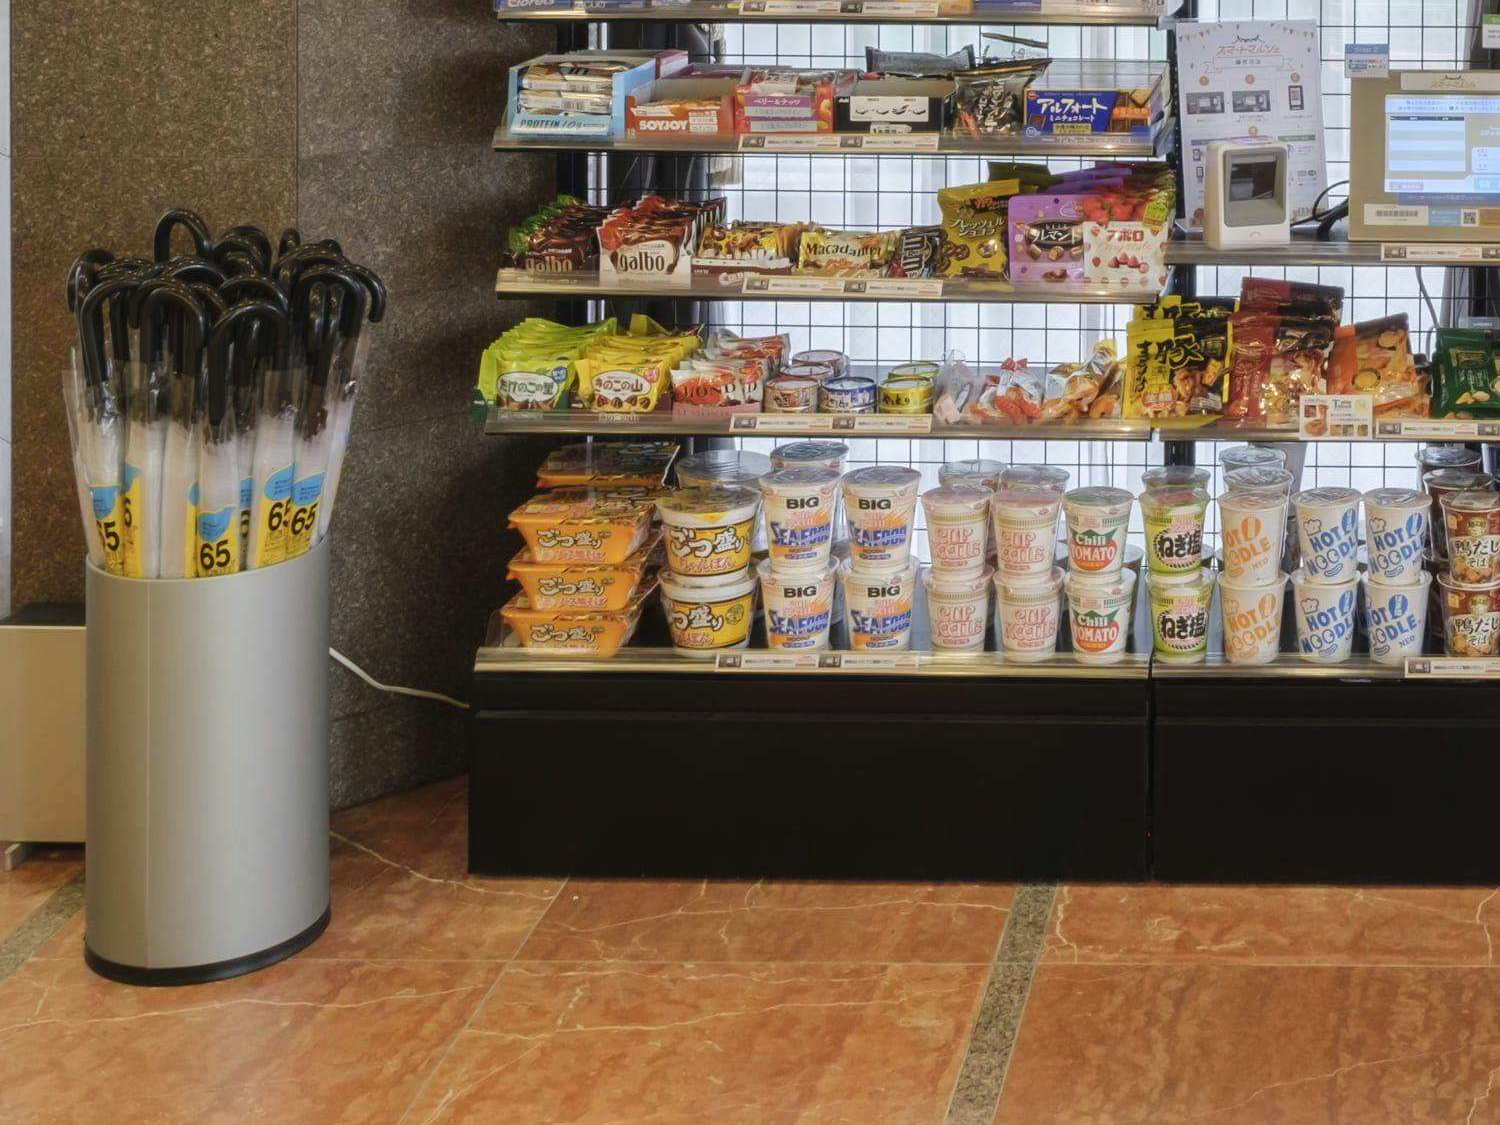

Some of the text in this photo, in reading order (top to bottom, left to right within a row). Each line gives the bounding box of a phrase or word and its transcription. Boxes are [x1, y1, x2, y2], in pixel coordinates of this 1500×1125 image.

[1036, 98, 1108, 114] アルフォート
[520, 119, 560, 129] PROTEIN
[638, 119, 688, 131] SOYJOY
[1049, 114, 1095, 123] ミニチョコレート
[1106, 229, 1145, 243] アポロ
[619, 252, 665, 272] galbo
[594, 380, 643, 393] きのこの山
[786, 496, 820, 510] BIG
[858, 498, 892, 511] BIG
[291, 502, 319, 537] 65
[536, 528, 603, 550] ごつ盛り
[669, 525, 745, 559] ごつ盛り
[770, 522, 832, 546] SEAFOOD
[1073, 534, 1108, 546] Chili
[1309, 527, 1343, 554] HOT
[1374, 527, 1405, 552] HOT
[200, 538, 232, 570] 65
[1069, 545, 1118, 563] TOMATO
[1157, 533, 1202, 558] ねぎ塩
[1454, 539, 1500, 557] 鴨だし
[679, 556, 738, 570] ちゃんぽん
[1467, 556, 1487, 568] そば
[538, 577, 606, 597] ごつ盛り
[783, 585, 817, 599] BIG
[867, 585, 901, 598] BIG
[671, 603, 724, 631] つ盛り
[769, 610, 830, 636] SEAFOOD
[850, 611, 912, 636] SEAFOOD
[1077, 614, 1109, 626] Chili
[1229, 609, 1257, 633] HOT
[1306, 609, 1339, 633] HOT
[1454, 617, 1499, 634] 鴨だし
[530, 624, 596, 643] ごつ盛り
[1072, 625, 1120, 642] TOMATO
[1159, 614, 1206, 639] ねぎ塩
[1398, 634, 1416, 649] NEO
[1467, 634, 1488, 647] そば
